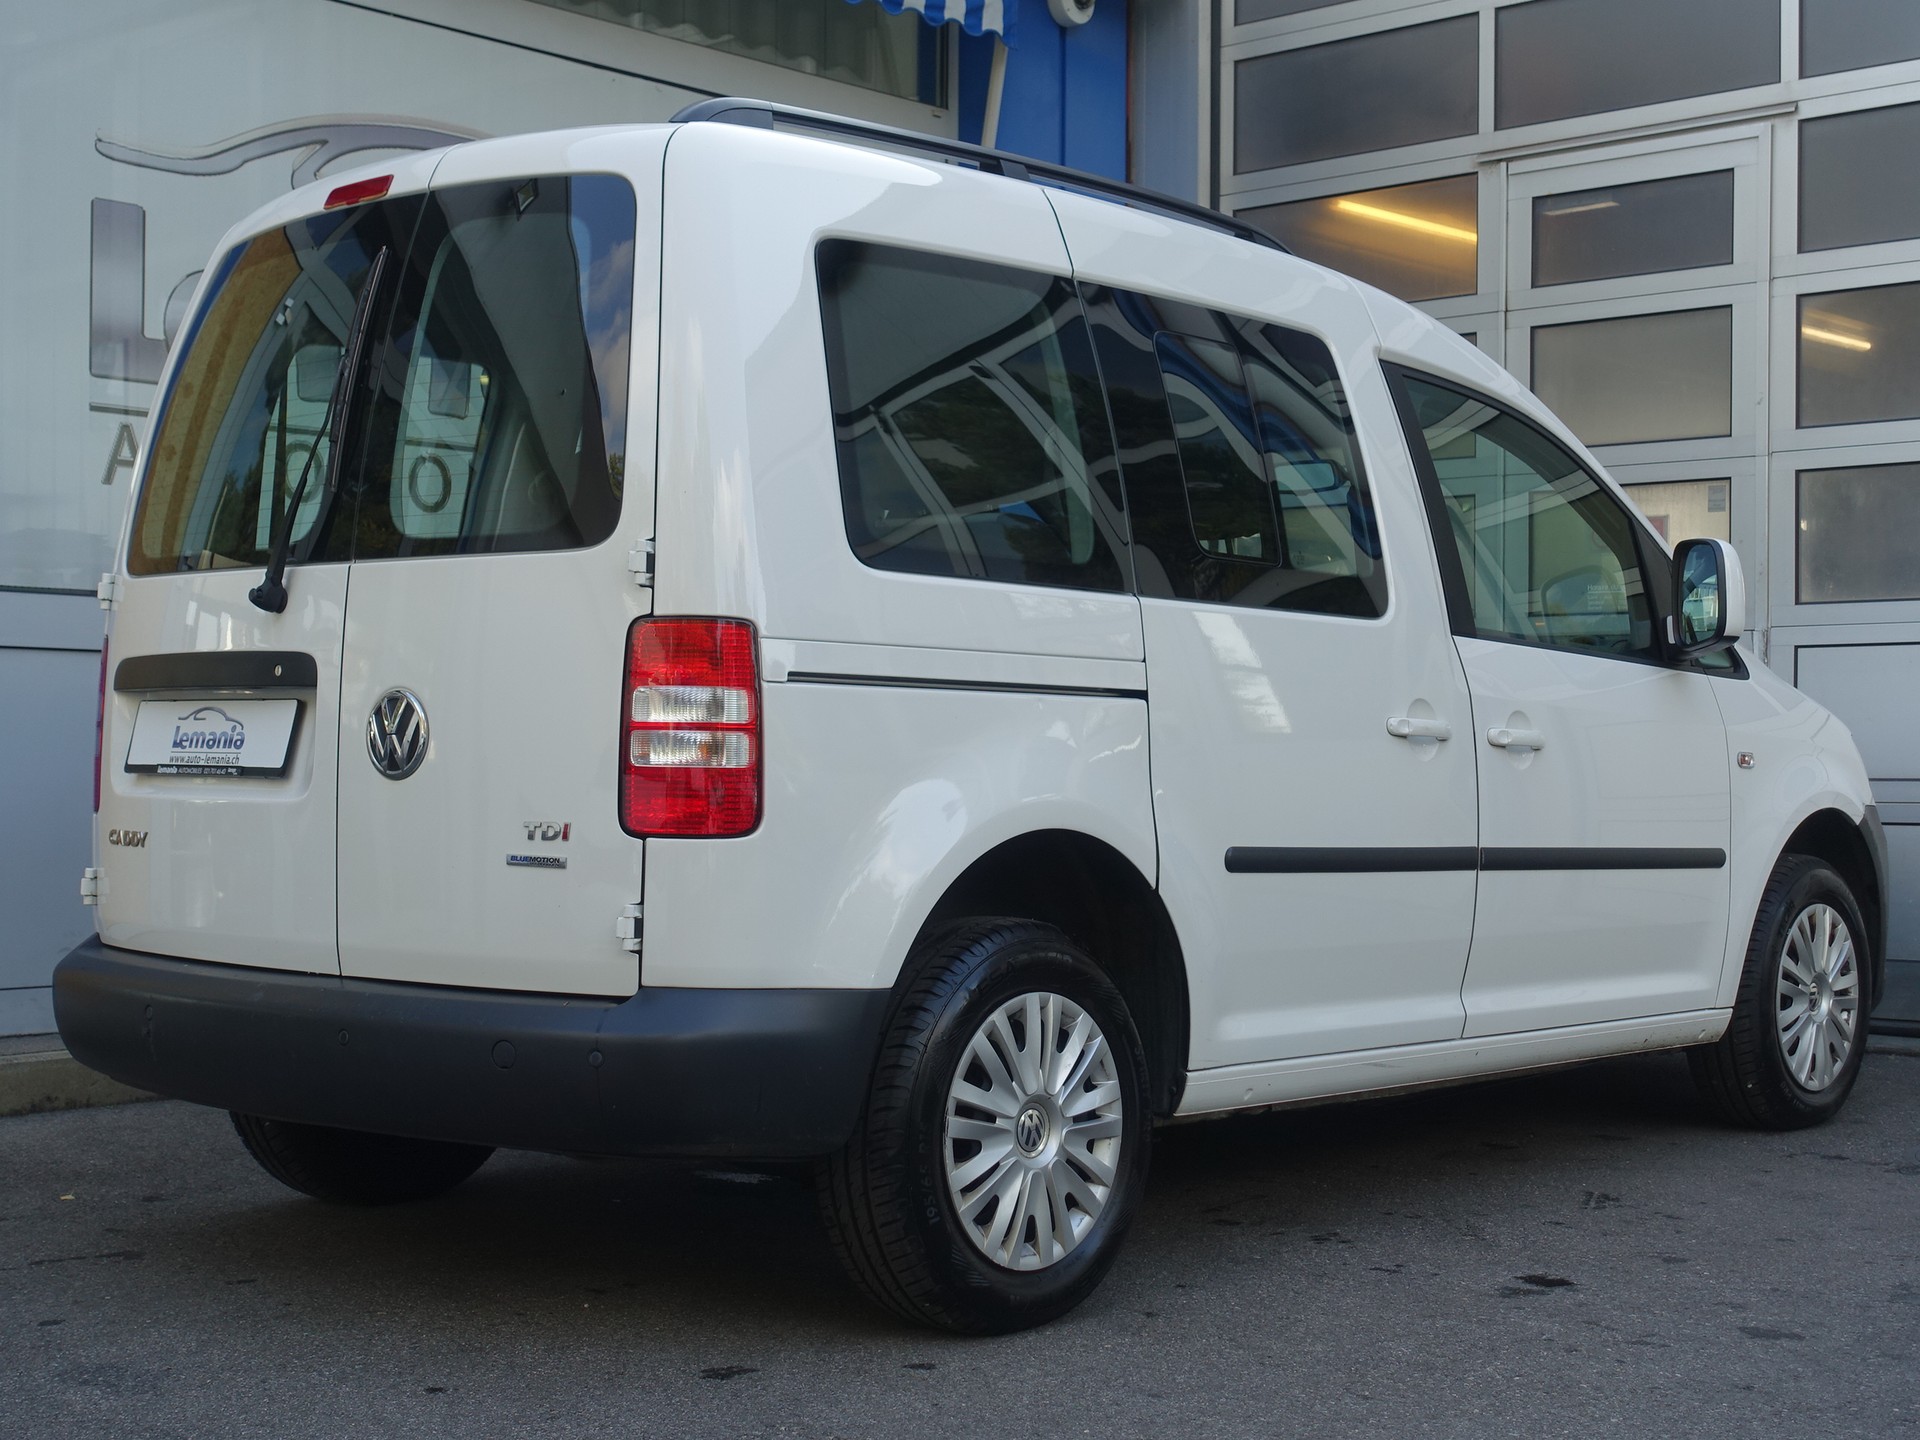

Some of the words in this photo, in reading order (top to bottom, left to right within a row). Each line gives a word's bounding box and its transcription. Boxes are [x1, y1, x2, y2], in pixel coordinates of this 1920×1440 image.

[172, 725, 245, 749] Lemania
[169, 754, 240, 764] www.auto-lemania.ch
[109, 829, 148, 848] CADDY
[523, 821, 571, 841] TDI
[510, 855, 560, 864] BLUEMOTION
